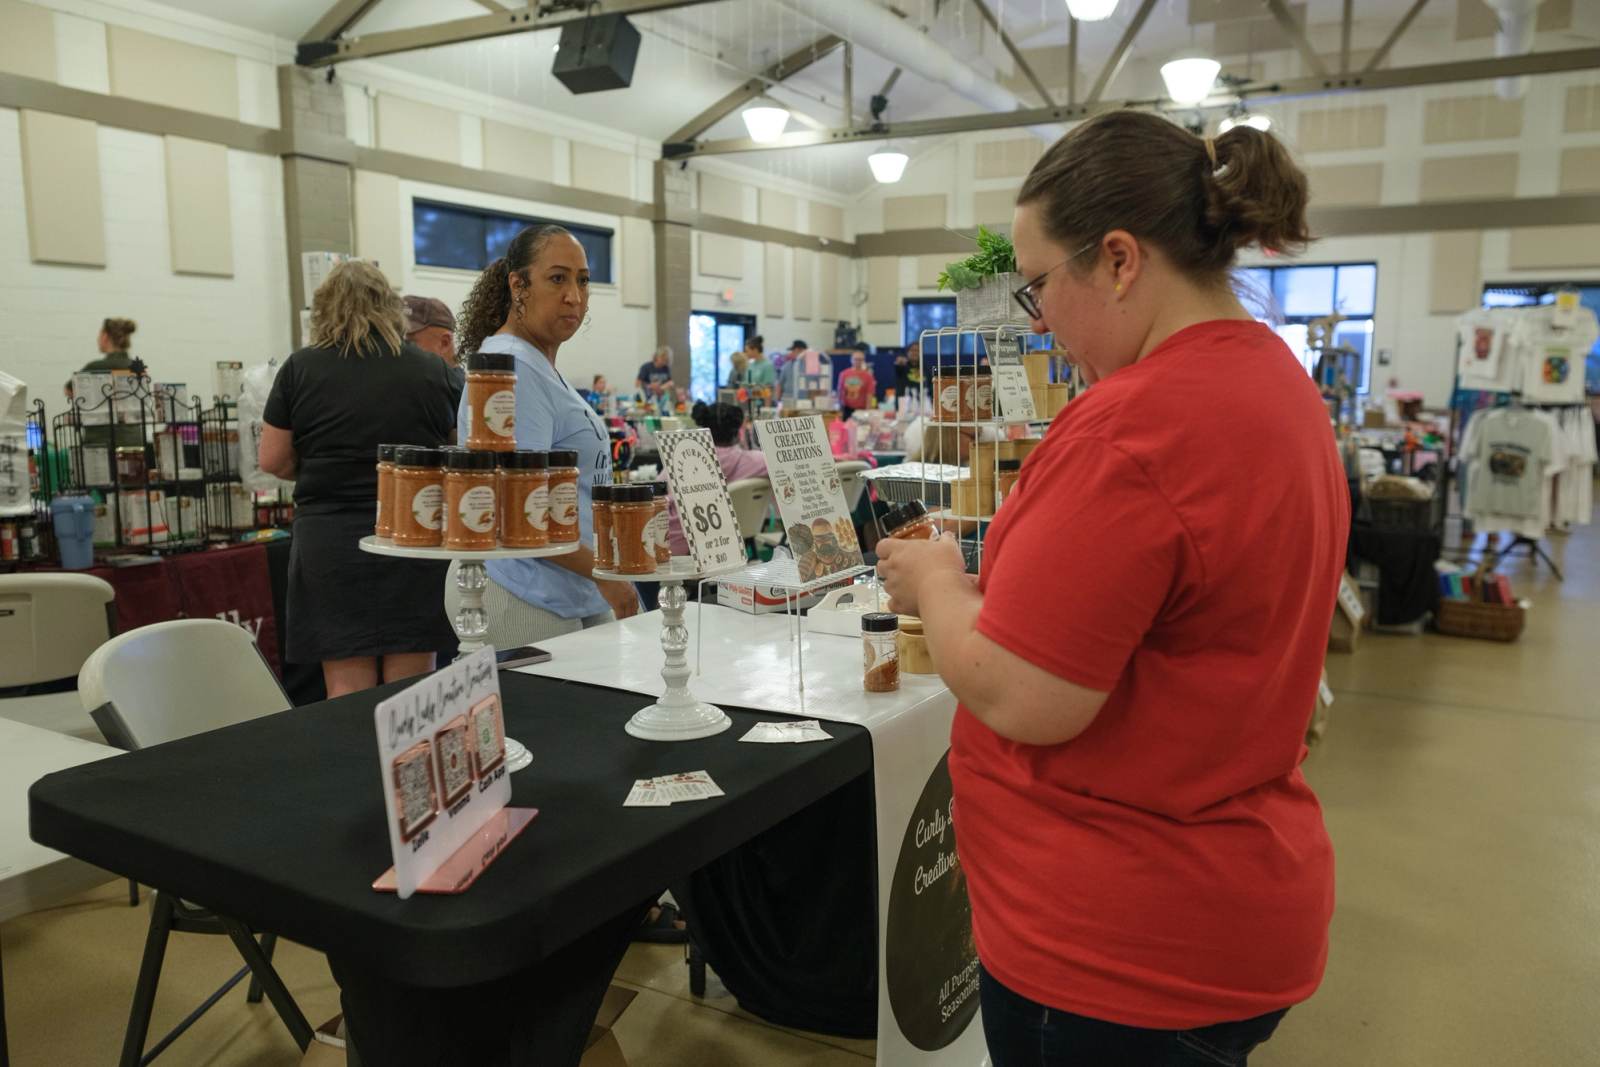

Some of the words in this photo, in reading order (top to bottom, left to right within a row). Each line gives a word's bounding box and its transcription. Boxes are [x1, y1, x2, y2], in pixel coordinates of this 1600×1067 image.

[766, 420, 792, 434] CURLY
[794, 417, 816, 431] LADY
[774, 432, 816, 448] CREATIVE
[682, 448, 716, 478] PURPOSE
[776, 445, 822, 463] CREATIONS
[682, 482, 718, 494] SEASONING
[693, 503, 722, 536] $6
[705, 541, 713, 549] or
[714, 538, 719, 548] 2
[719, 536, 729, 546] for
[916, 808, 946, 848] Curly
[915, 852, 956, 895] Creative
[939, 980, 950, 1005] All
[942, 973, 980, 1023] Seasoning
